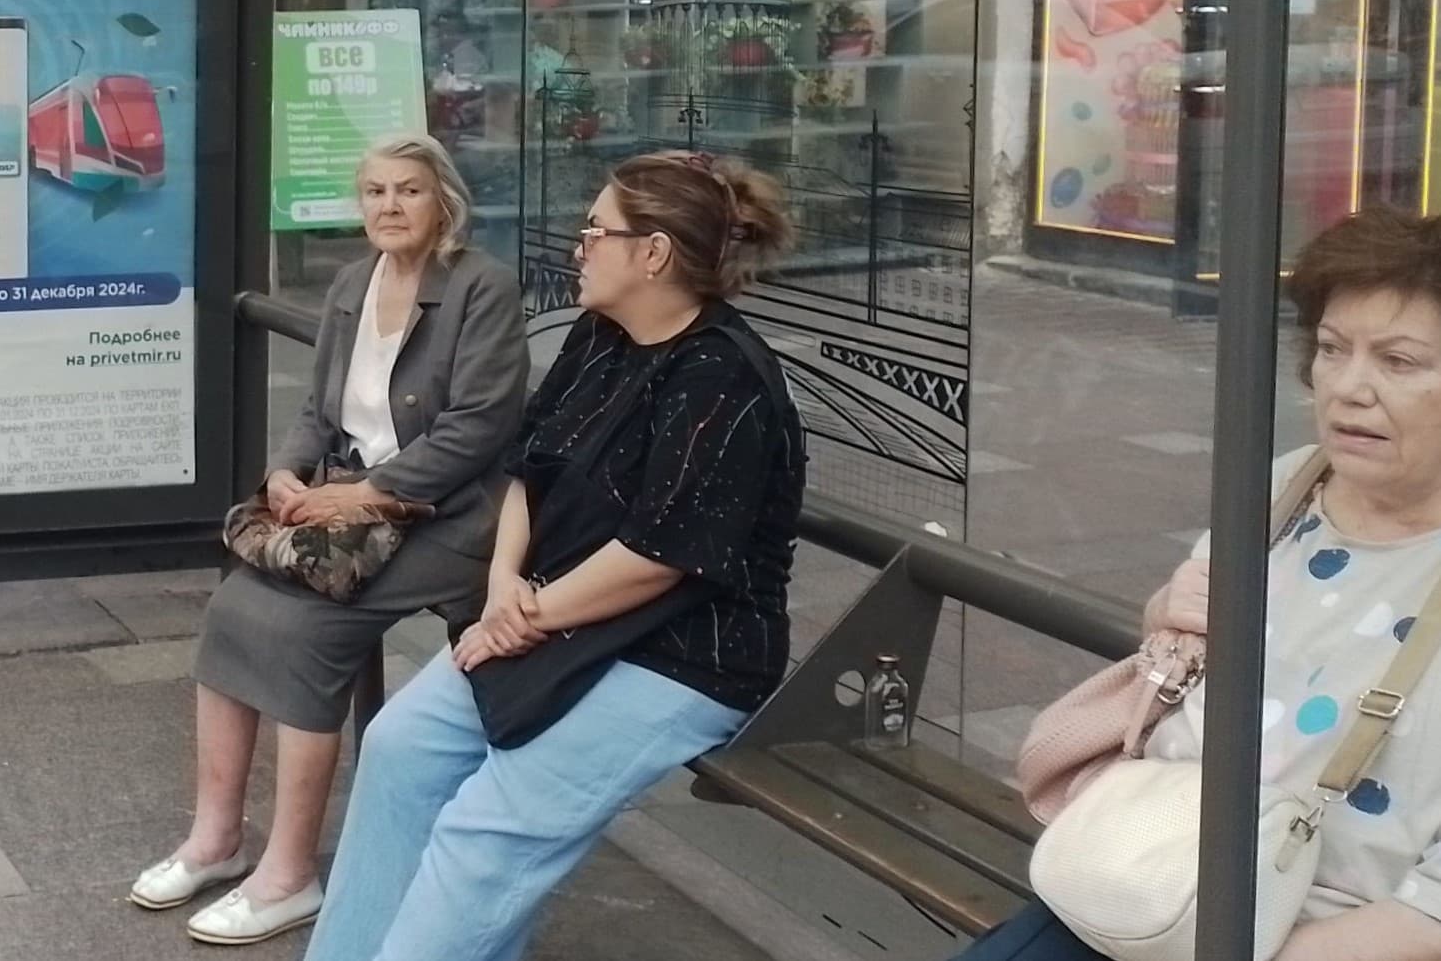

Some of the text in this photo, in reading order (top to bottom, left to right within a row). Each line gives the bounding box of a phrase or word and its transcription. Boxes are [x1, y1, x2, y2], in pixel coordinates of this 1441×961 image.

[308, 78, 332, 95] по
[11, 286, 27, 300] 31
[30, 283, 95, 302] декабря
[99, 282, 146, 298] 2024г.
[89, 327, 181, 347] Подробнее
[66, 349, 182, 367] на privetmir.ru
